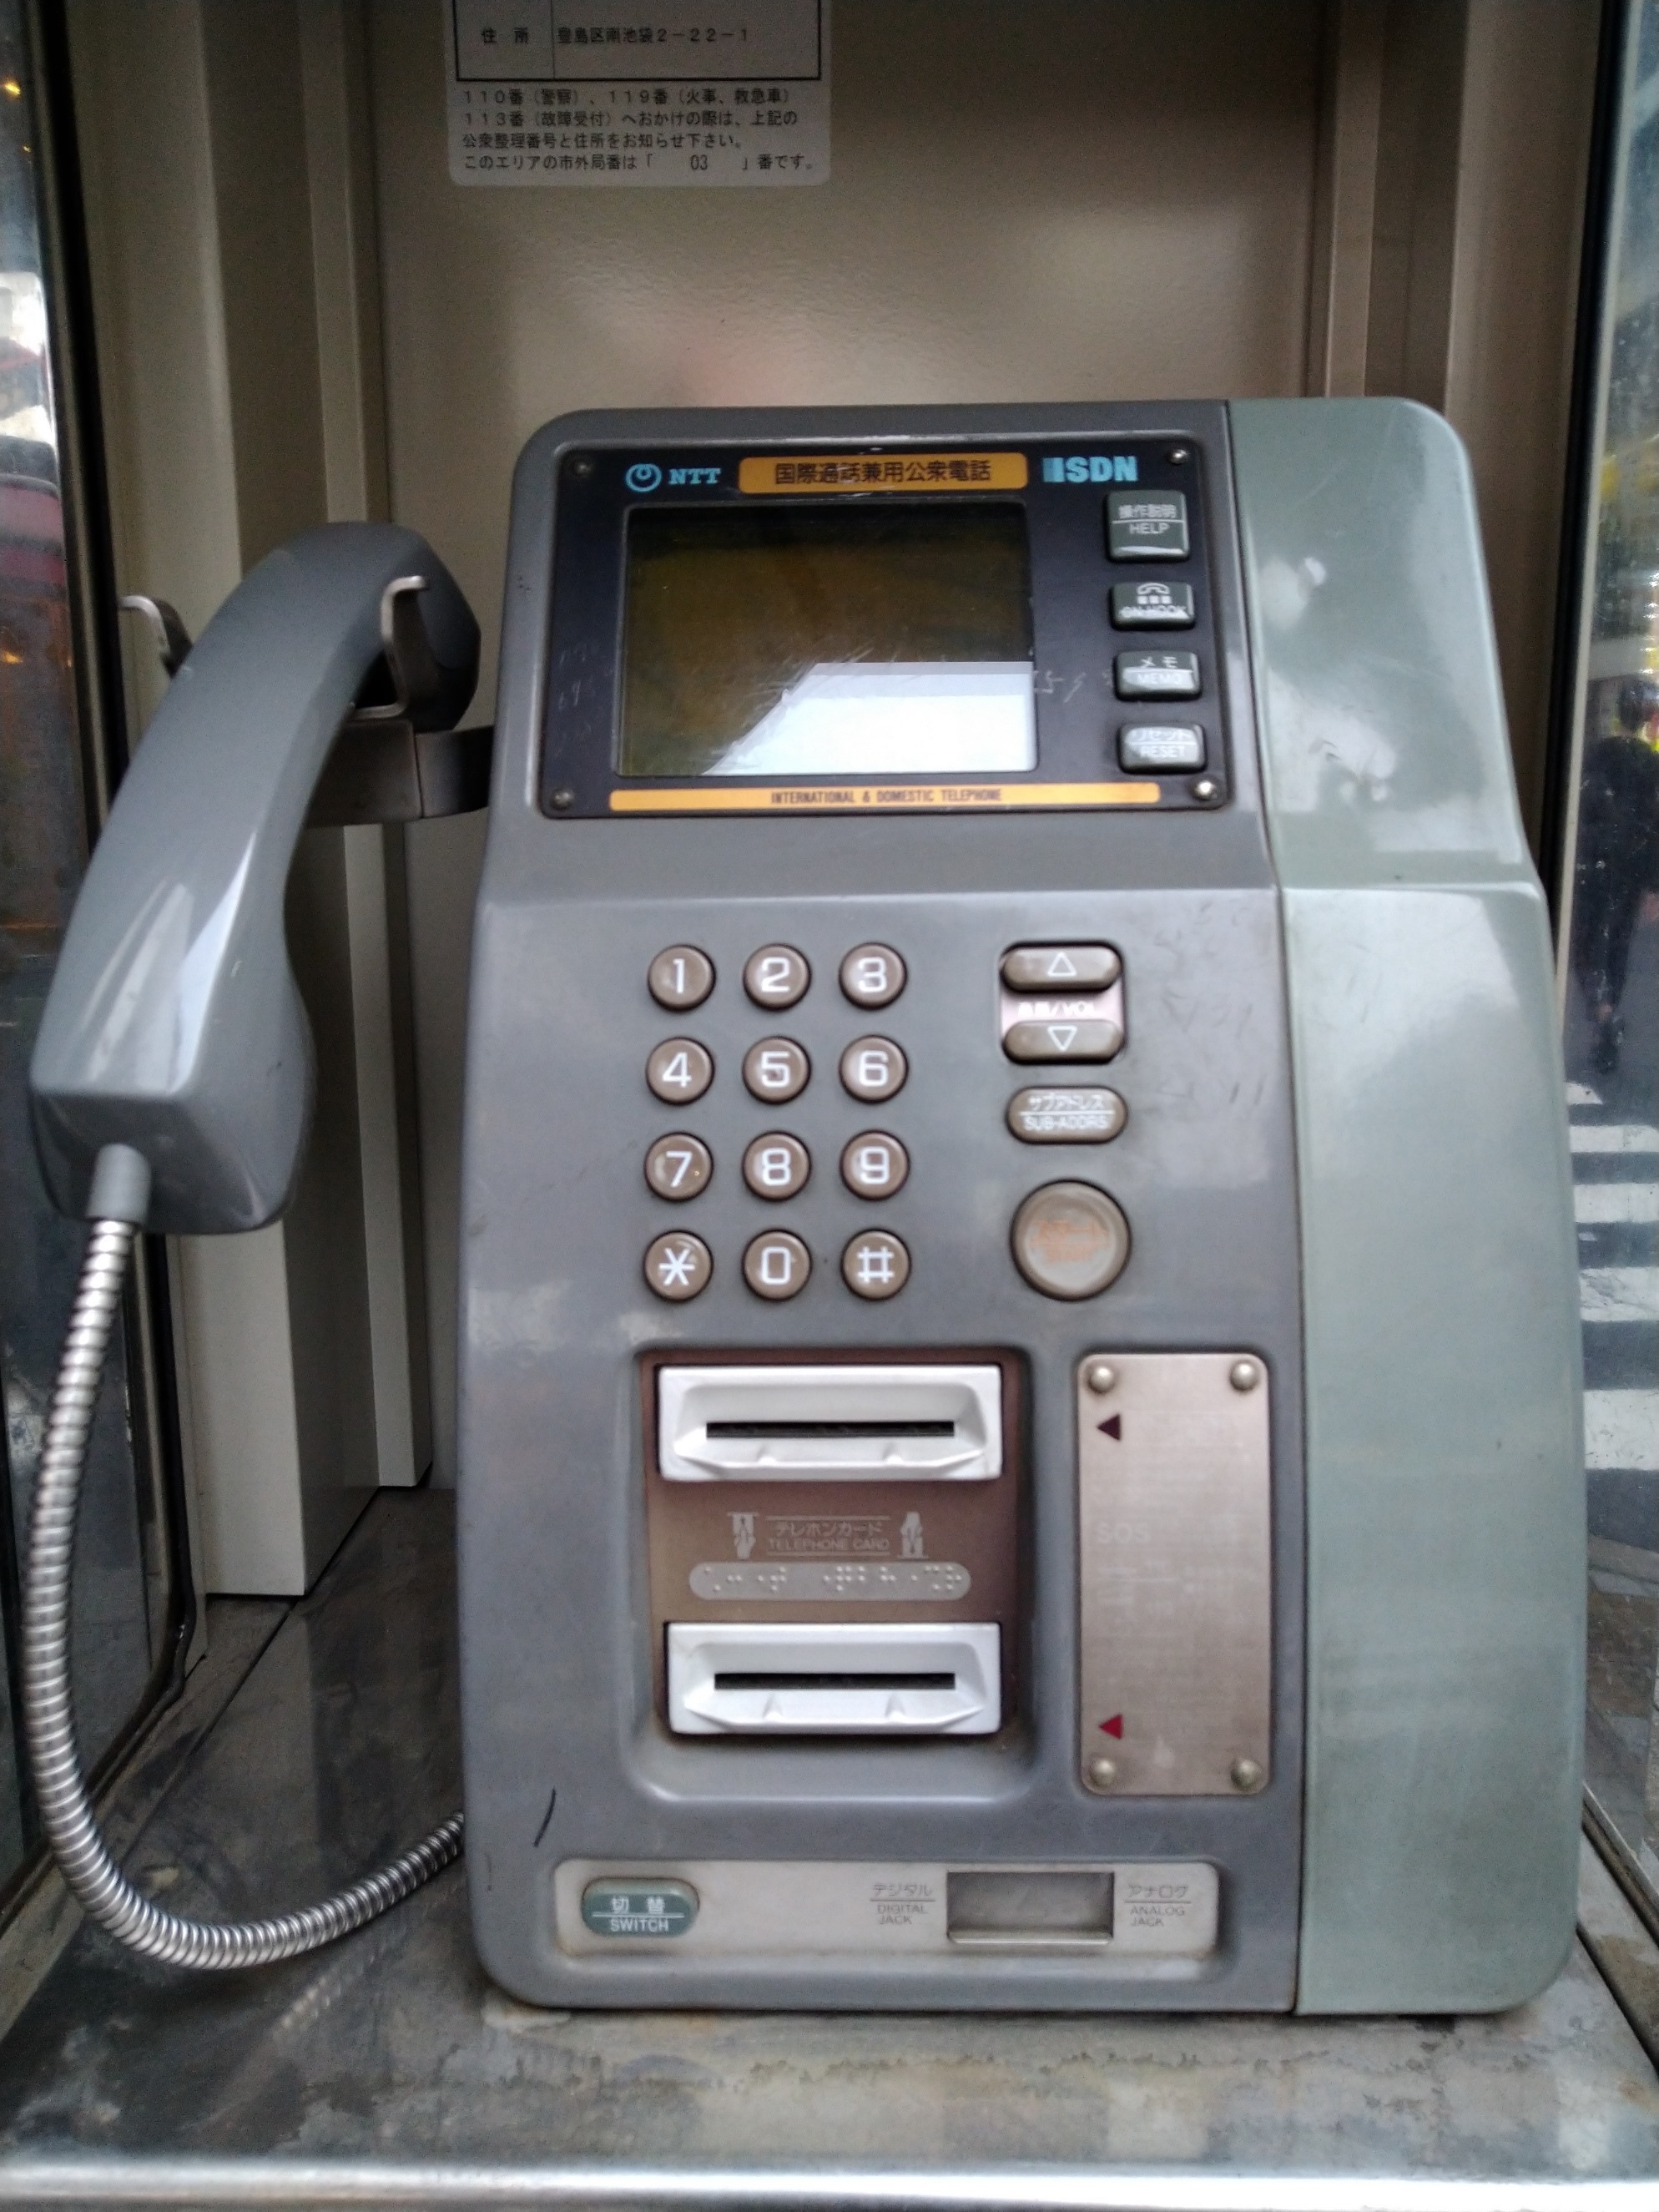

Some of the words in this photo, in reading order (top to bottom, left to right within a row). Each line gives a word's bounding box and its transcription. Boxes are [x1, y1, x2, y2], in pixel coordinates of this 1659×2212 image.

[668, 467, 721, 485] NTT
[775, 460, 991, 484] 国際通話兼用公衆電話
[1042, 456, 1138, 482] ISDN
[1129, 523, 1170, 534] HELP
[770, 790, 855, 803] INTERNATIONAL
[861, 790, 871, 802] &
[876, 790, 934, 802] DOMESTIC
[940, 789, 1001, 801] TELEPHONE
[673, 958, 684, 993] 1
[760, 957, 791, 992] 2
[858, 957, 887, 992] 3
[663, 1052, 692, 1087] 4
[760, 1052, 791, 1087] 5
[858, 1051, 889, 1086] 6
[666, 1151, 693, 1188] 7
[761, 1149, 791, 1185] 8
[859, 1147, 890, 1184] 9
[761, 1247, 791, 1285] 0
[857, 1247, 894, 1283] #
[768, 1538, 850, 1551] TELEPHONE
[853, 1538, 890, 1551] CARD
[774, 1521, 882, 1538] テレホンカード
[610, 1917, 669, 1932] SWITCH
[876, 1904, 928, 1915] DIGITAL
[878, 1915, 912, 1925] JACK
[1130, 1906, 1184, 1916] ANALOG
